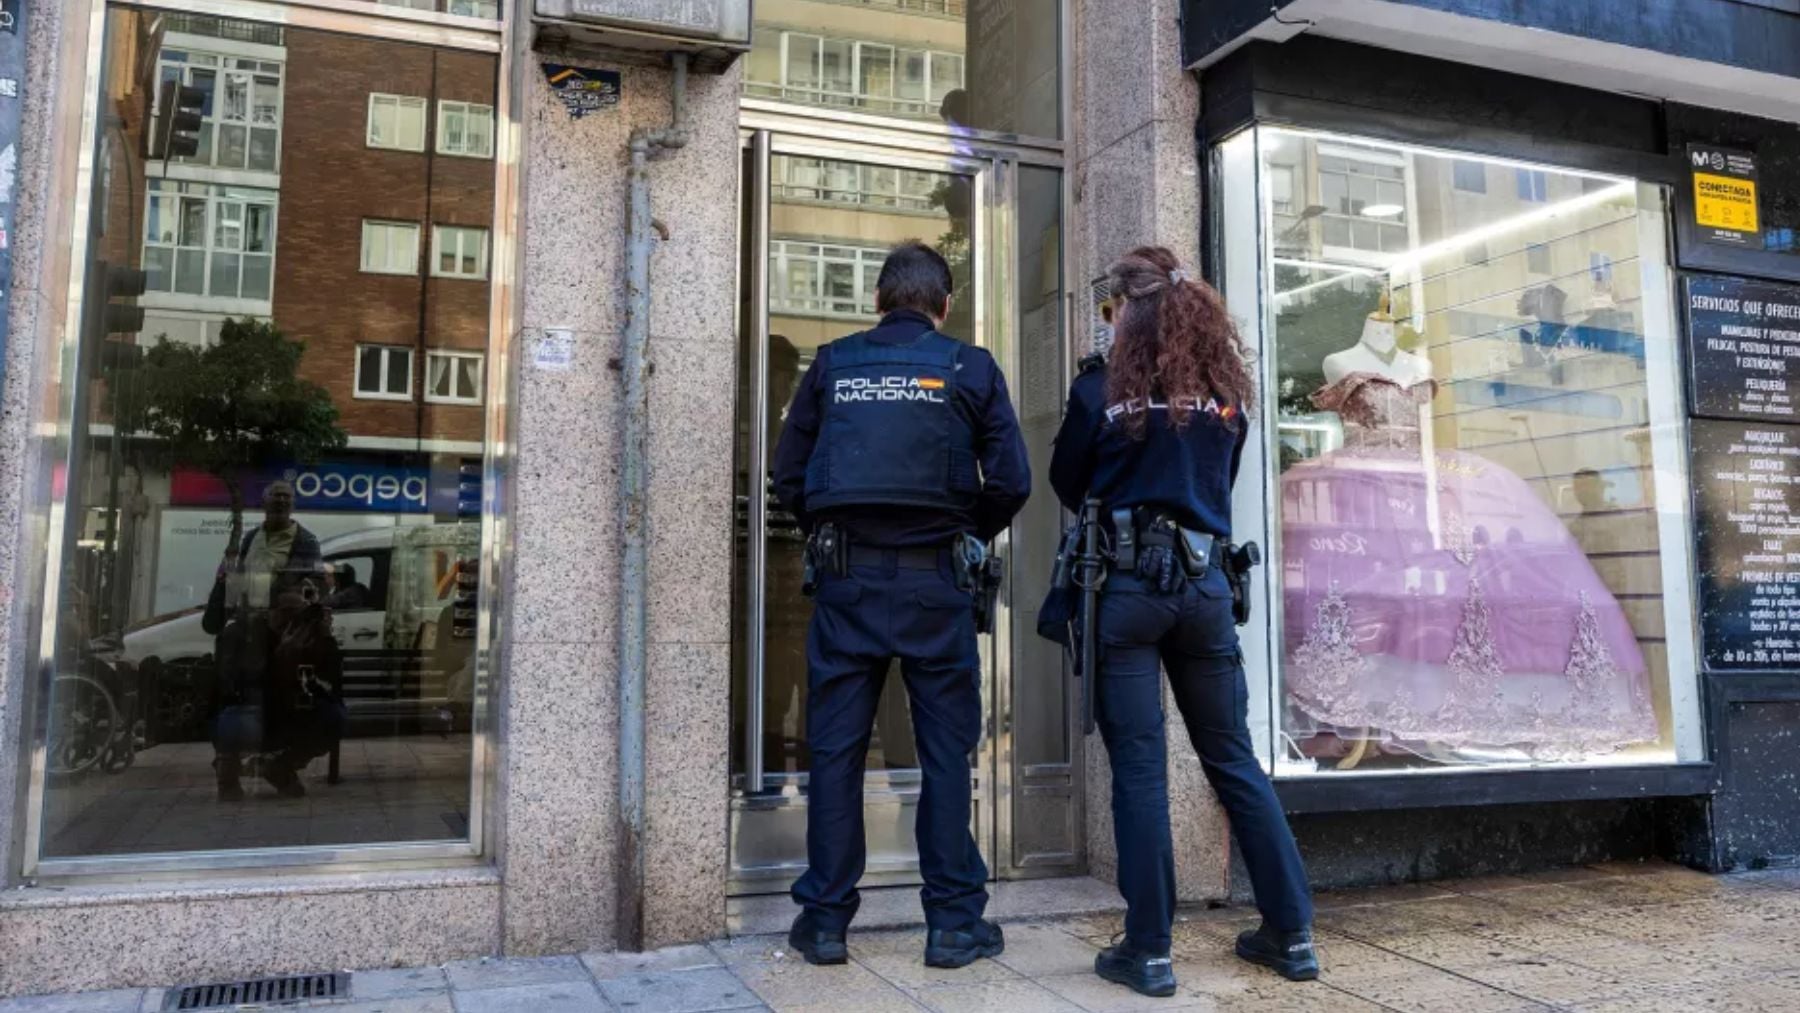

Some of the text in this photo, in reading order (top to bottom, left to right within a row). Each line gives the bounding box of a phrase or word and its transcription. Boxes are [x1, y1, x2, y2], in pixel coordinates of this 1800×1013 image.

[1692, 295, 1800, 320] SERVICIOS QUE OFRECE
[835, 376, 920, 391] POLICIA
[834, 389, 944, 404] NACIONAL
[1105, 397, 1220, 422] POLCIA
[1723, 649, 1734, 661] de
[1736, 650, 1746, 661] 10
[1771, 649, 1782, 661] de
